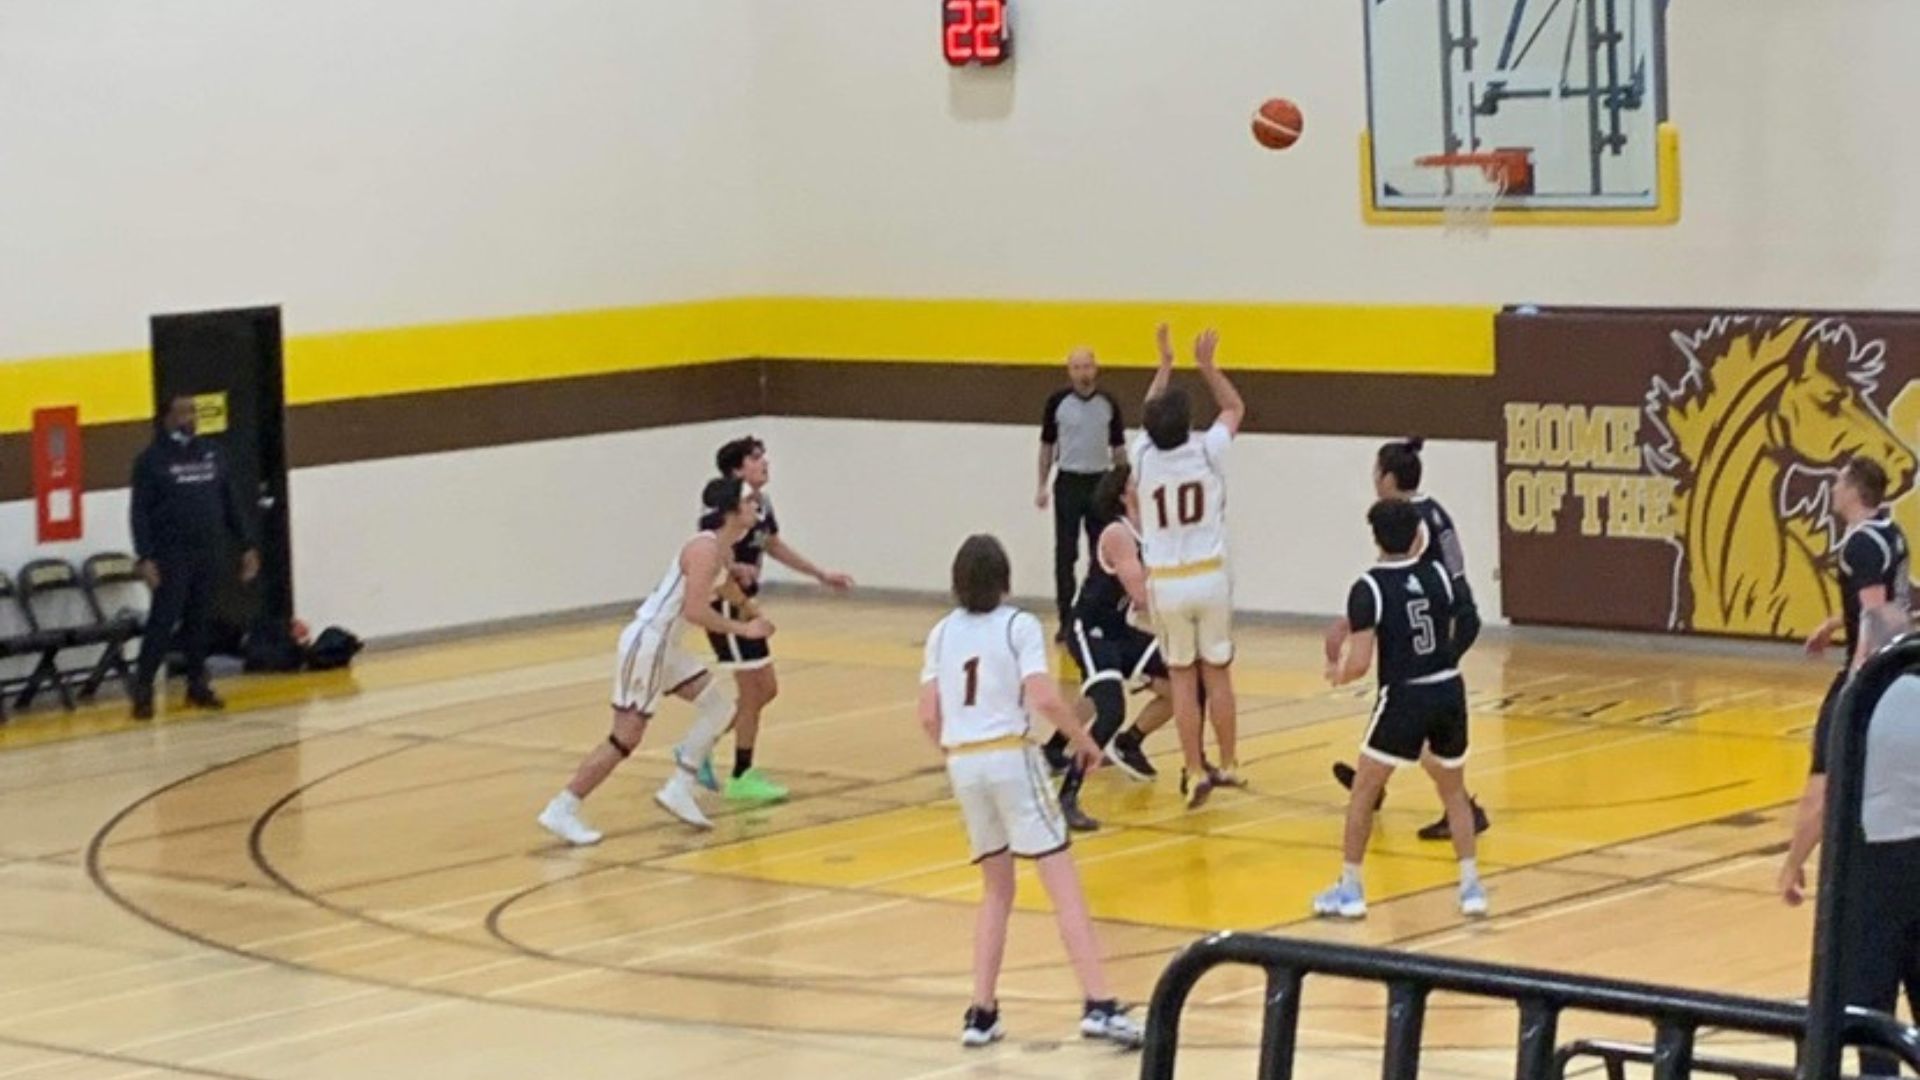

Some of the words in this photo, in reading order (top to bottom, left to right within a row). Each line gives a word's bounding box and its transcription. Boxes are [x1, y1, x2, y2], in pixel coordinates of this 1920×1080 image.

[947, 0, 1000, 57] 22
[1505, 403, 1641, 469] HOME
[1153, 481, 1204, 529] 10
[1506, 470, 1567, 533] OF
[1573, 473, 1679, 538] THE
[1407, 599, 1436, 655] 5
[963, 657, 980, 706] 1
